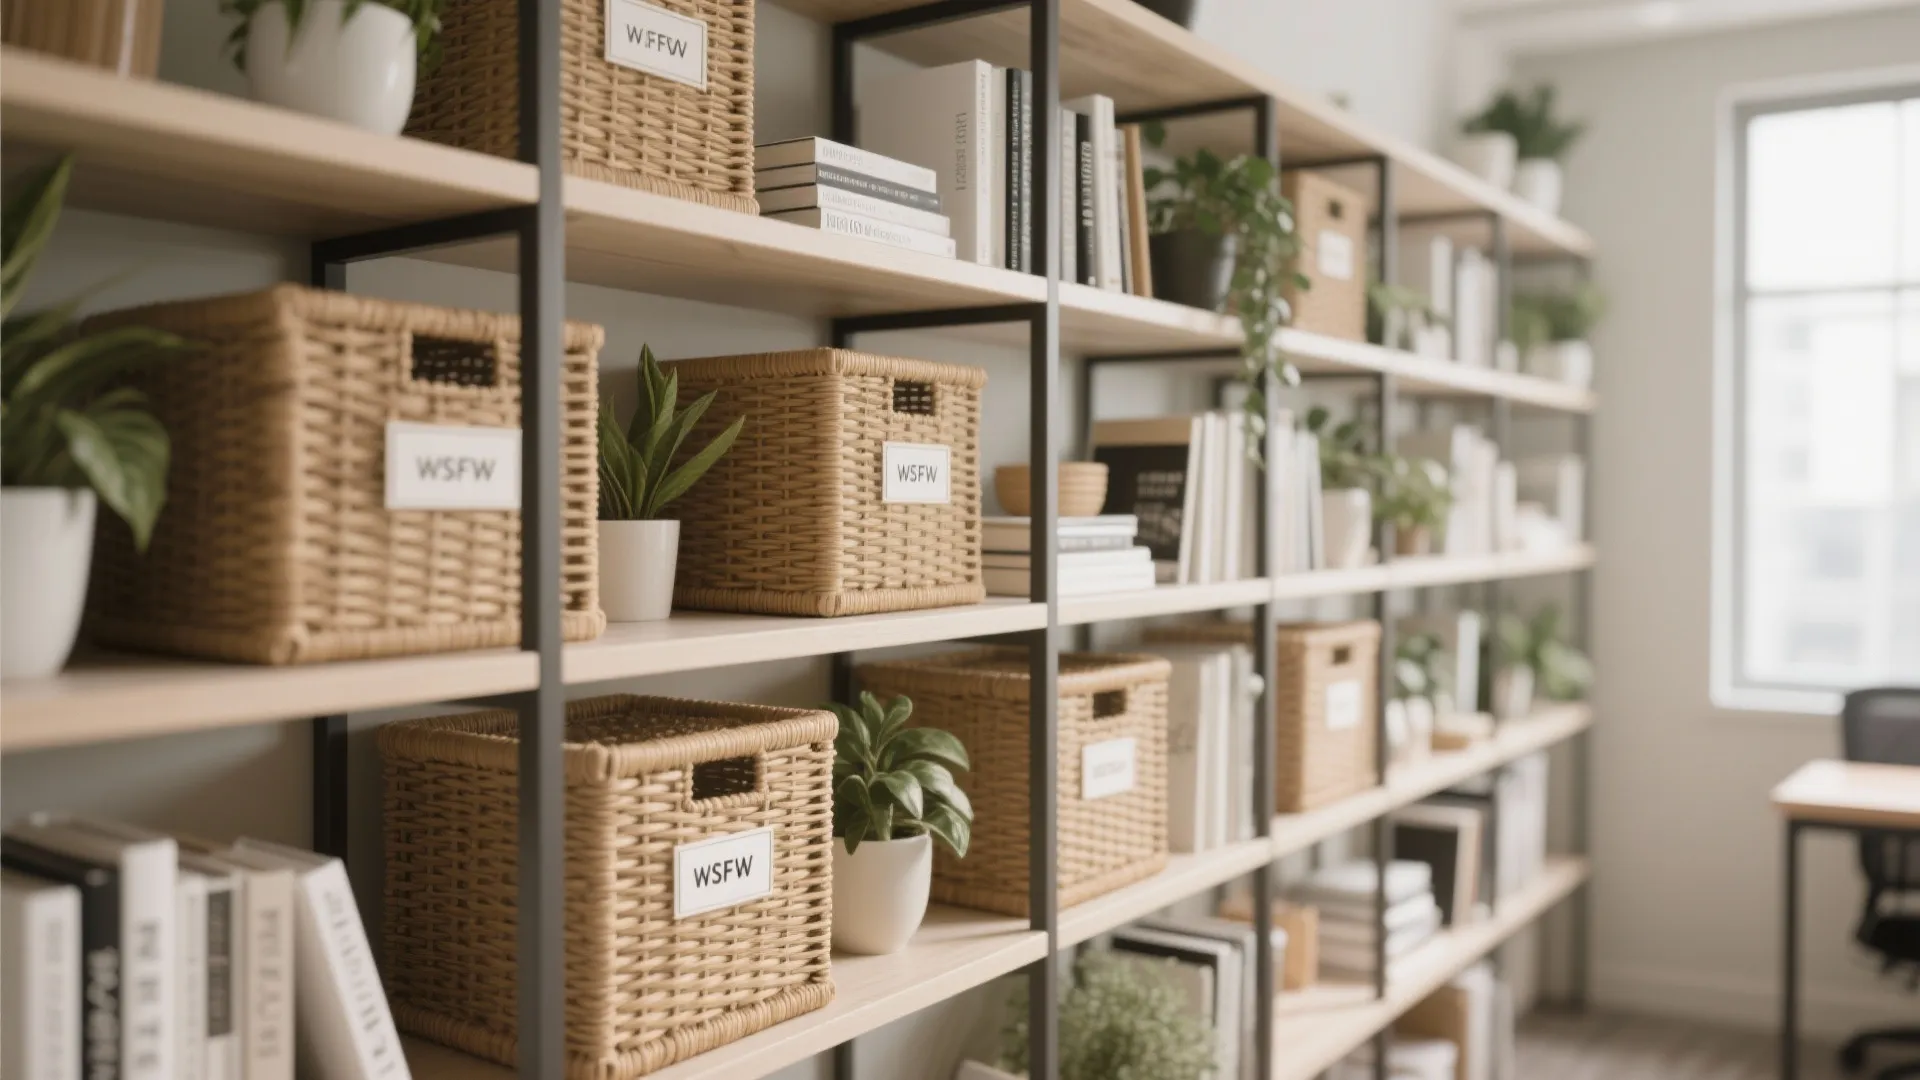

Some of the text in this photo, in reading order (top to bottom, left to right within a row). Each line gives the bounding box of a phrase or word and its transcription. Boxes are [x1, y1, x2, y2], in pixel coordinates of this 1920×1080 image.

[416, 456, 496, 481] WSFW
[897, 464, 938, 483] WSFW
[693, 854, 753, 888] WSFW
